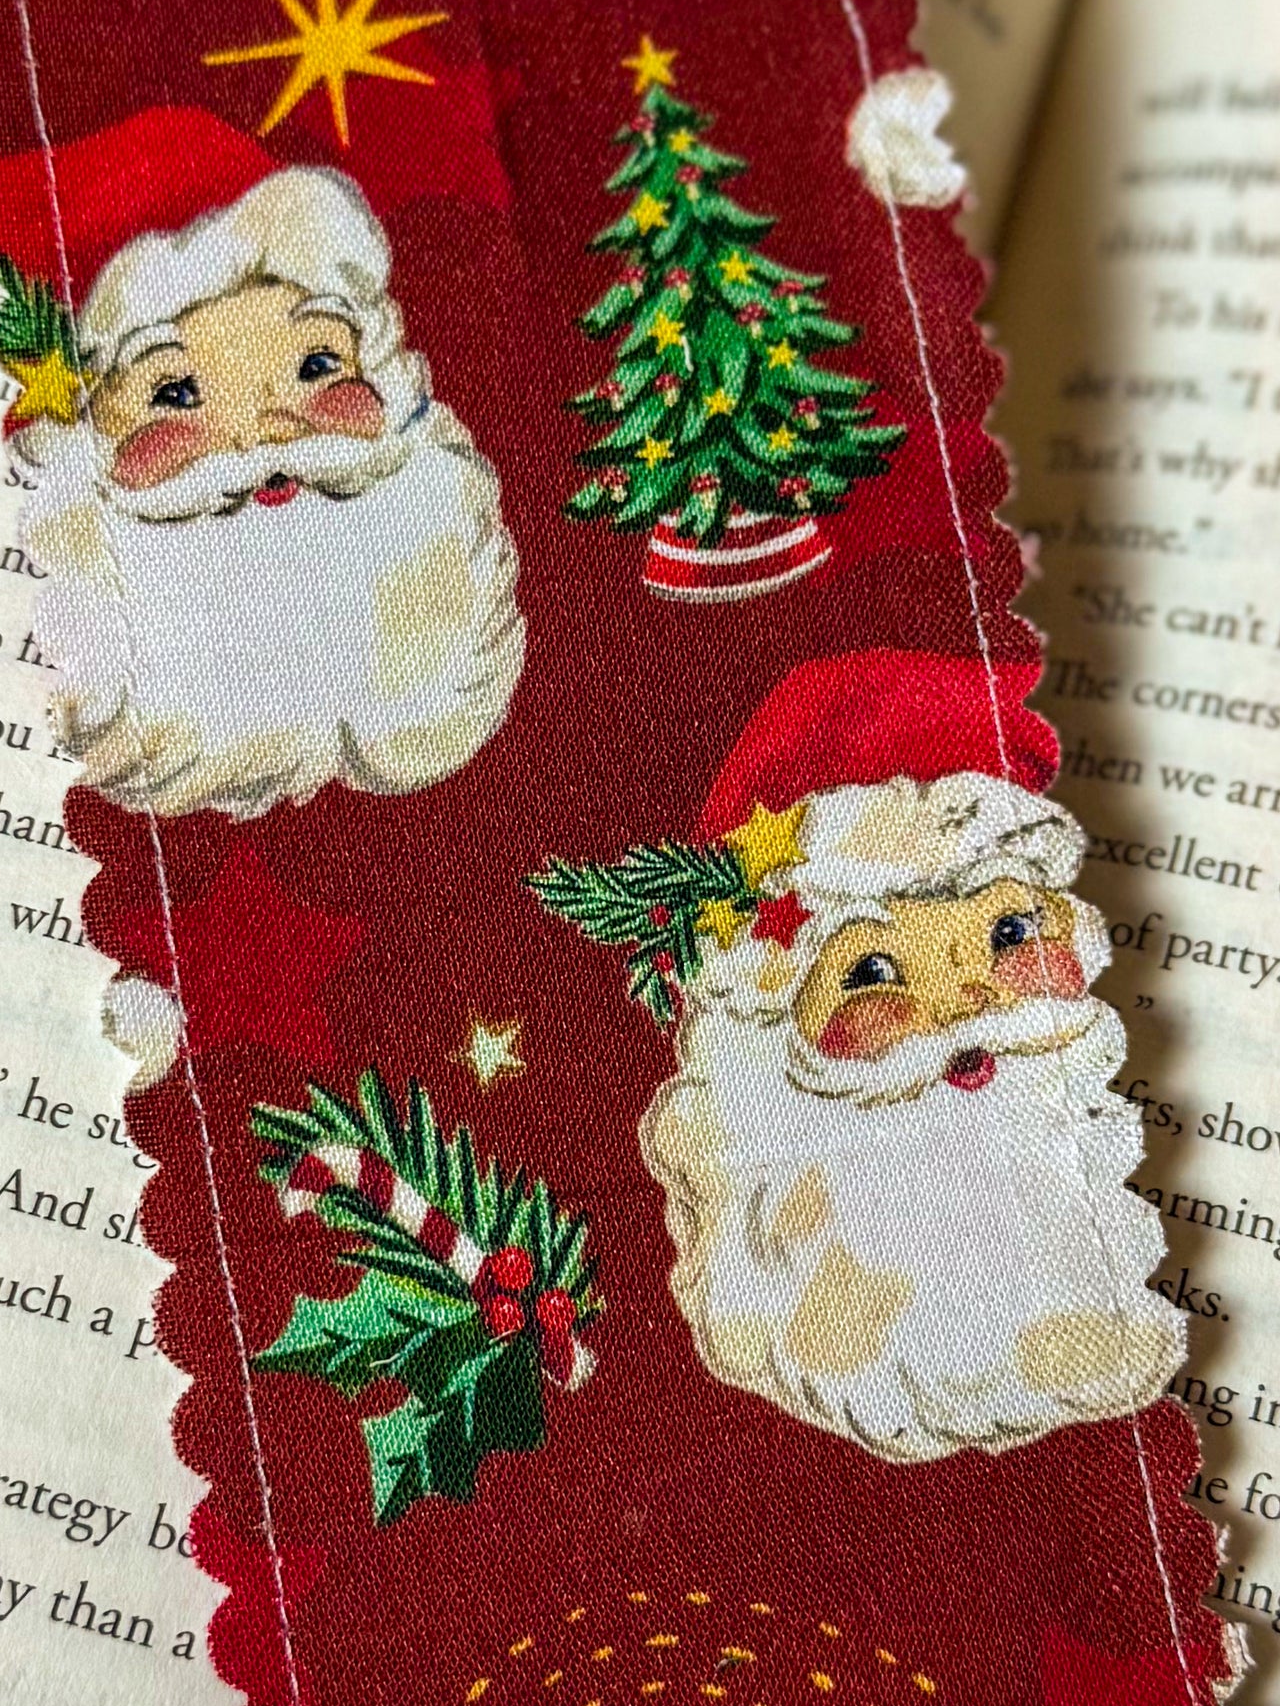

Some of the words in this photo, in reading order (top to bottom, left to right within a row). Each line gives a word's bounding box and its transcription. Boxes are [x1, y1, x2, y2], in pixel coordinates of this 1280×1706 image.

[1162, 600, 1268, 644] can’t
[1162, 768, 1215, 797] we
[48, 1580, 154, 1649] than
[171, 1630, 196, 1661] a
